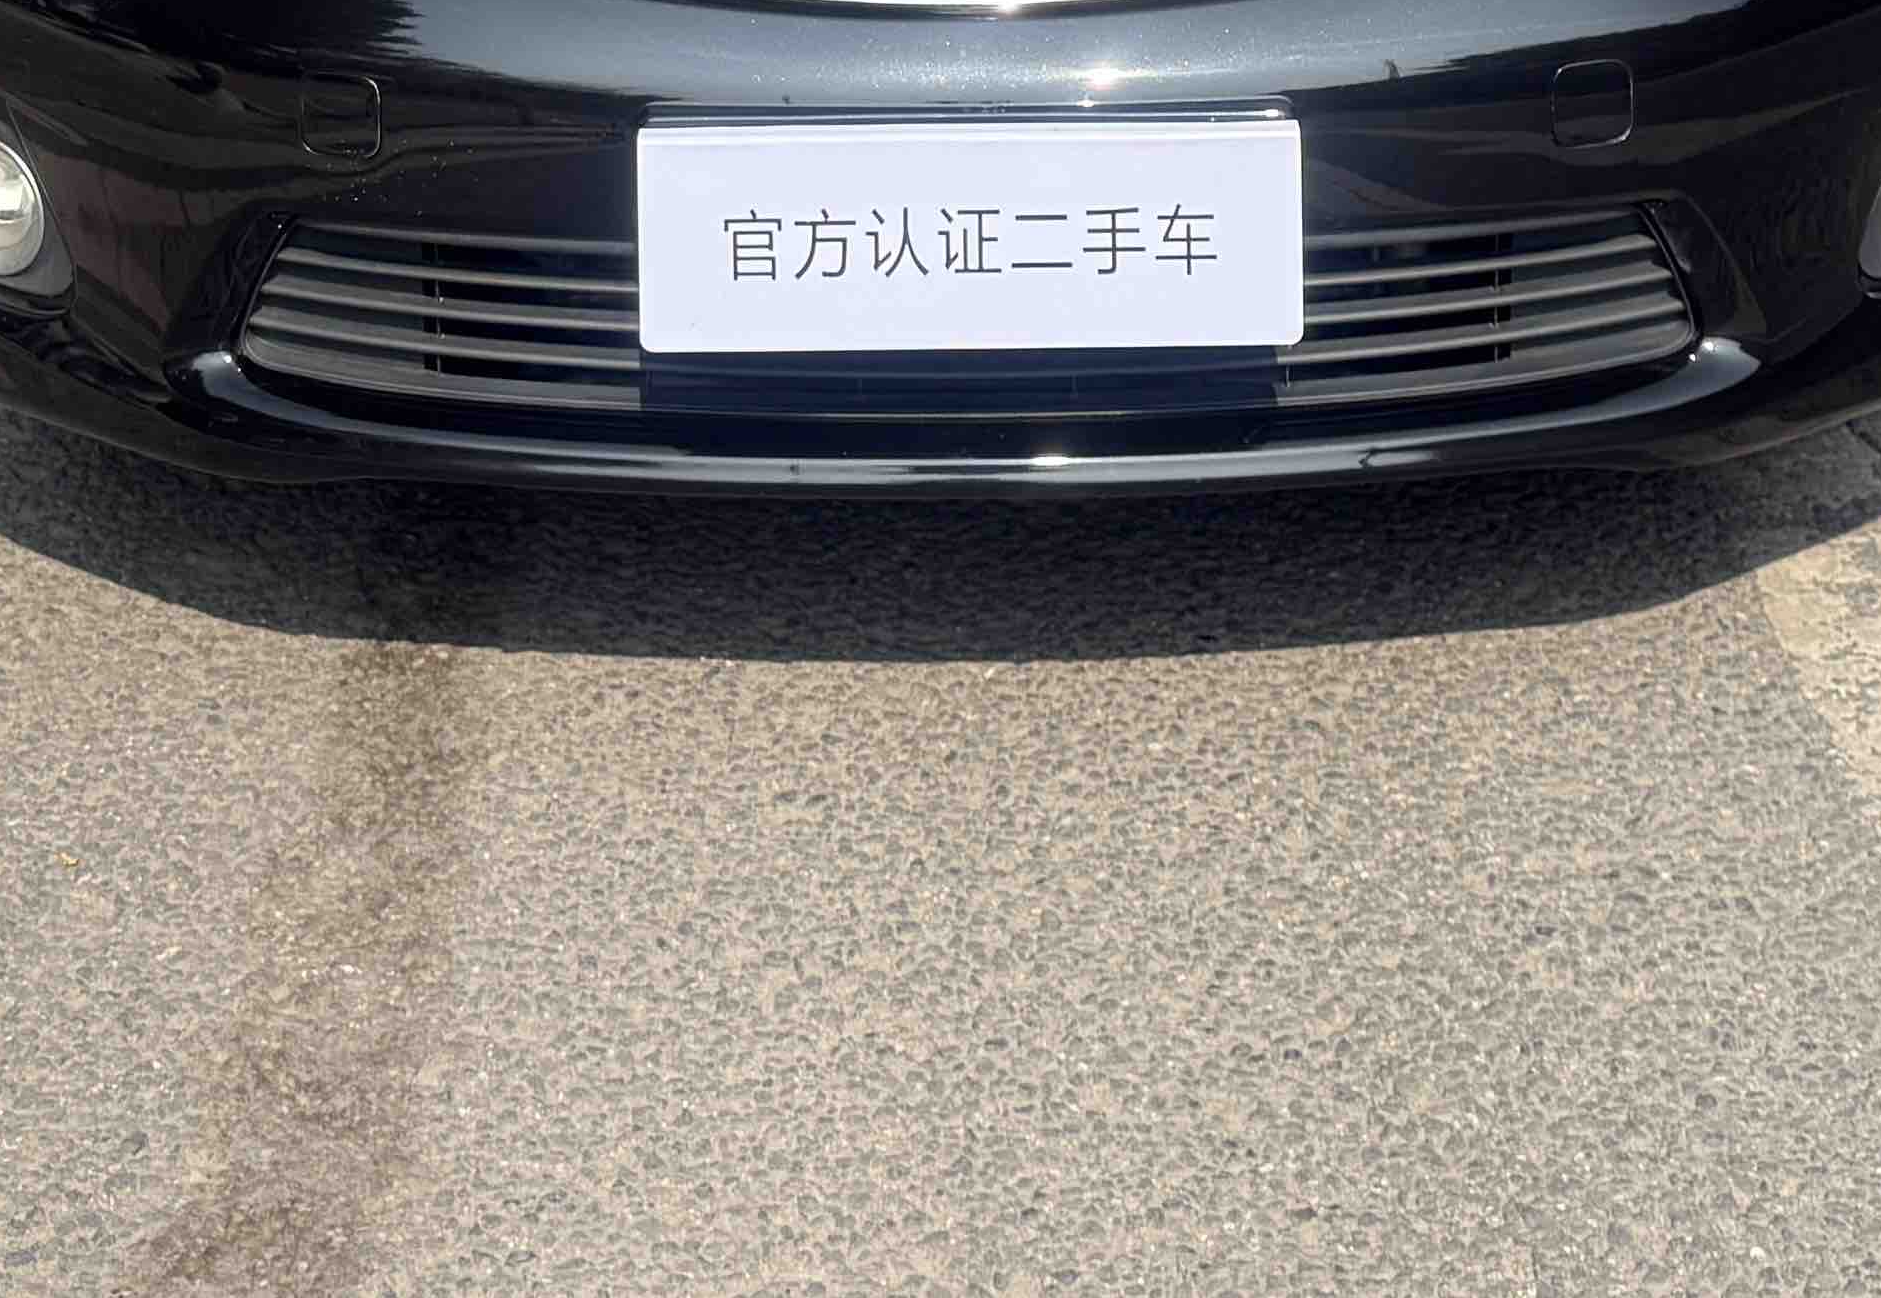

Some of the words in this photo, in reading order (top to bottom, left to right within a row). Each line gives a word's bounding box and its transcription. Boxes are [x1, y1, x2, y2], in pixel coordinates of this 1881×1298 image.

[722, 203, 1218, 281] 官方认证二手车
